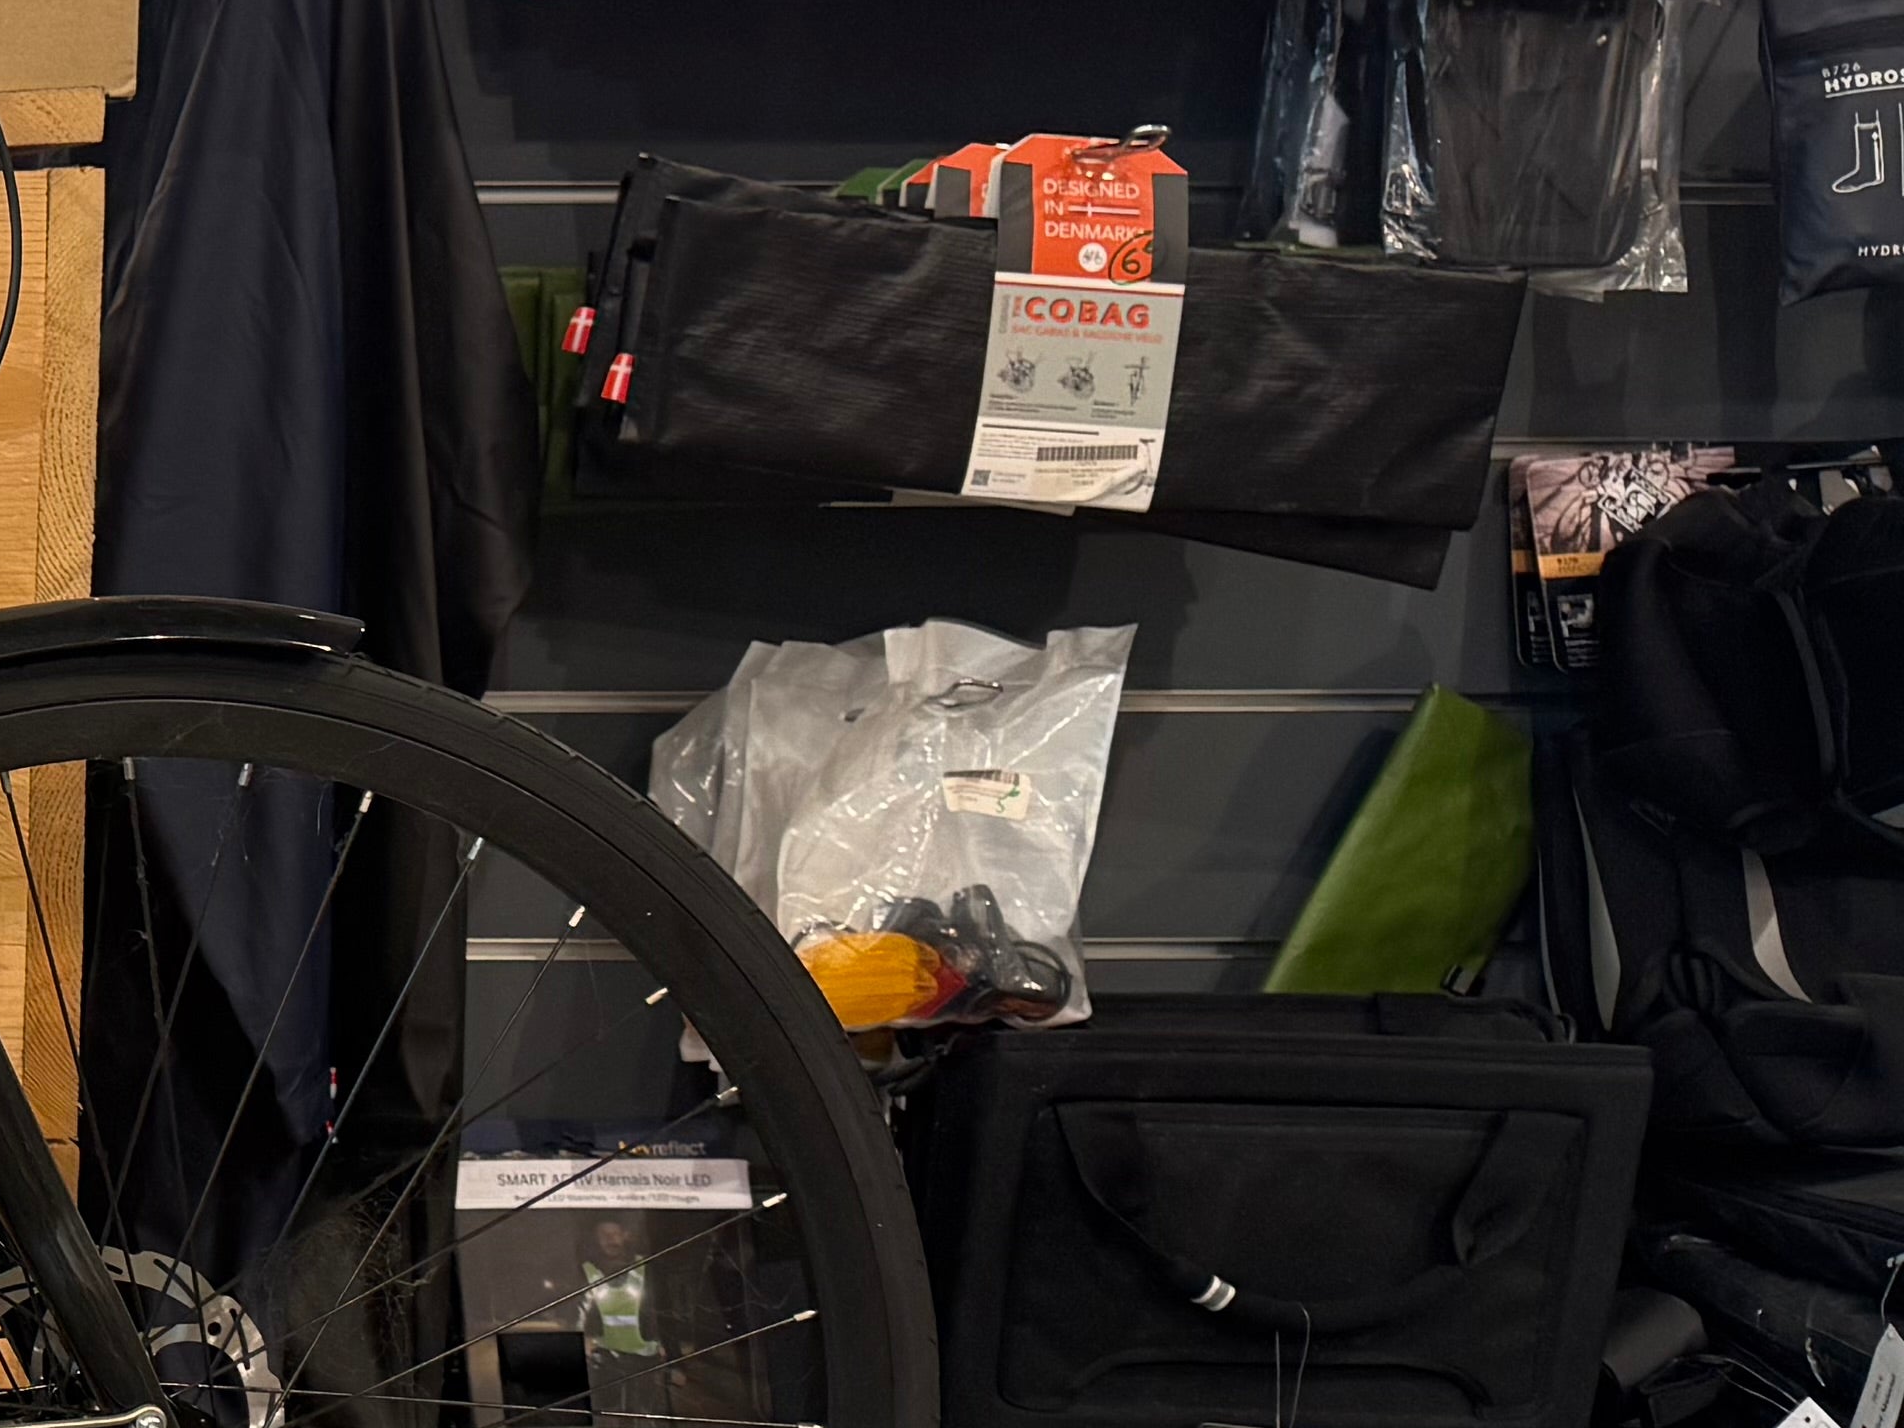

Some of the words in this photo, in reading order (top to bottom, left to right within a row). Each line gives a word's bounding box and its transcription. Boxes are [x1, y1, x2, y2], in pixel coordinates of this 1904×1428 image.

[1043, 178, 1140, 199] DESIGNED
[1044, 200, 1064, 216] IN
[1025, 296, 1151, 329] COBAG
[497, 1174, 546, 1187] SMART
[597, 1174, 651, 1187] Harnais
[654, 1174, 680, 1187] Noir
[684, 1174, 713, 1188] LED
